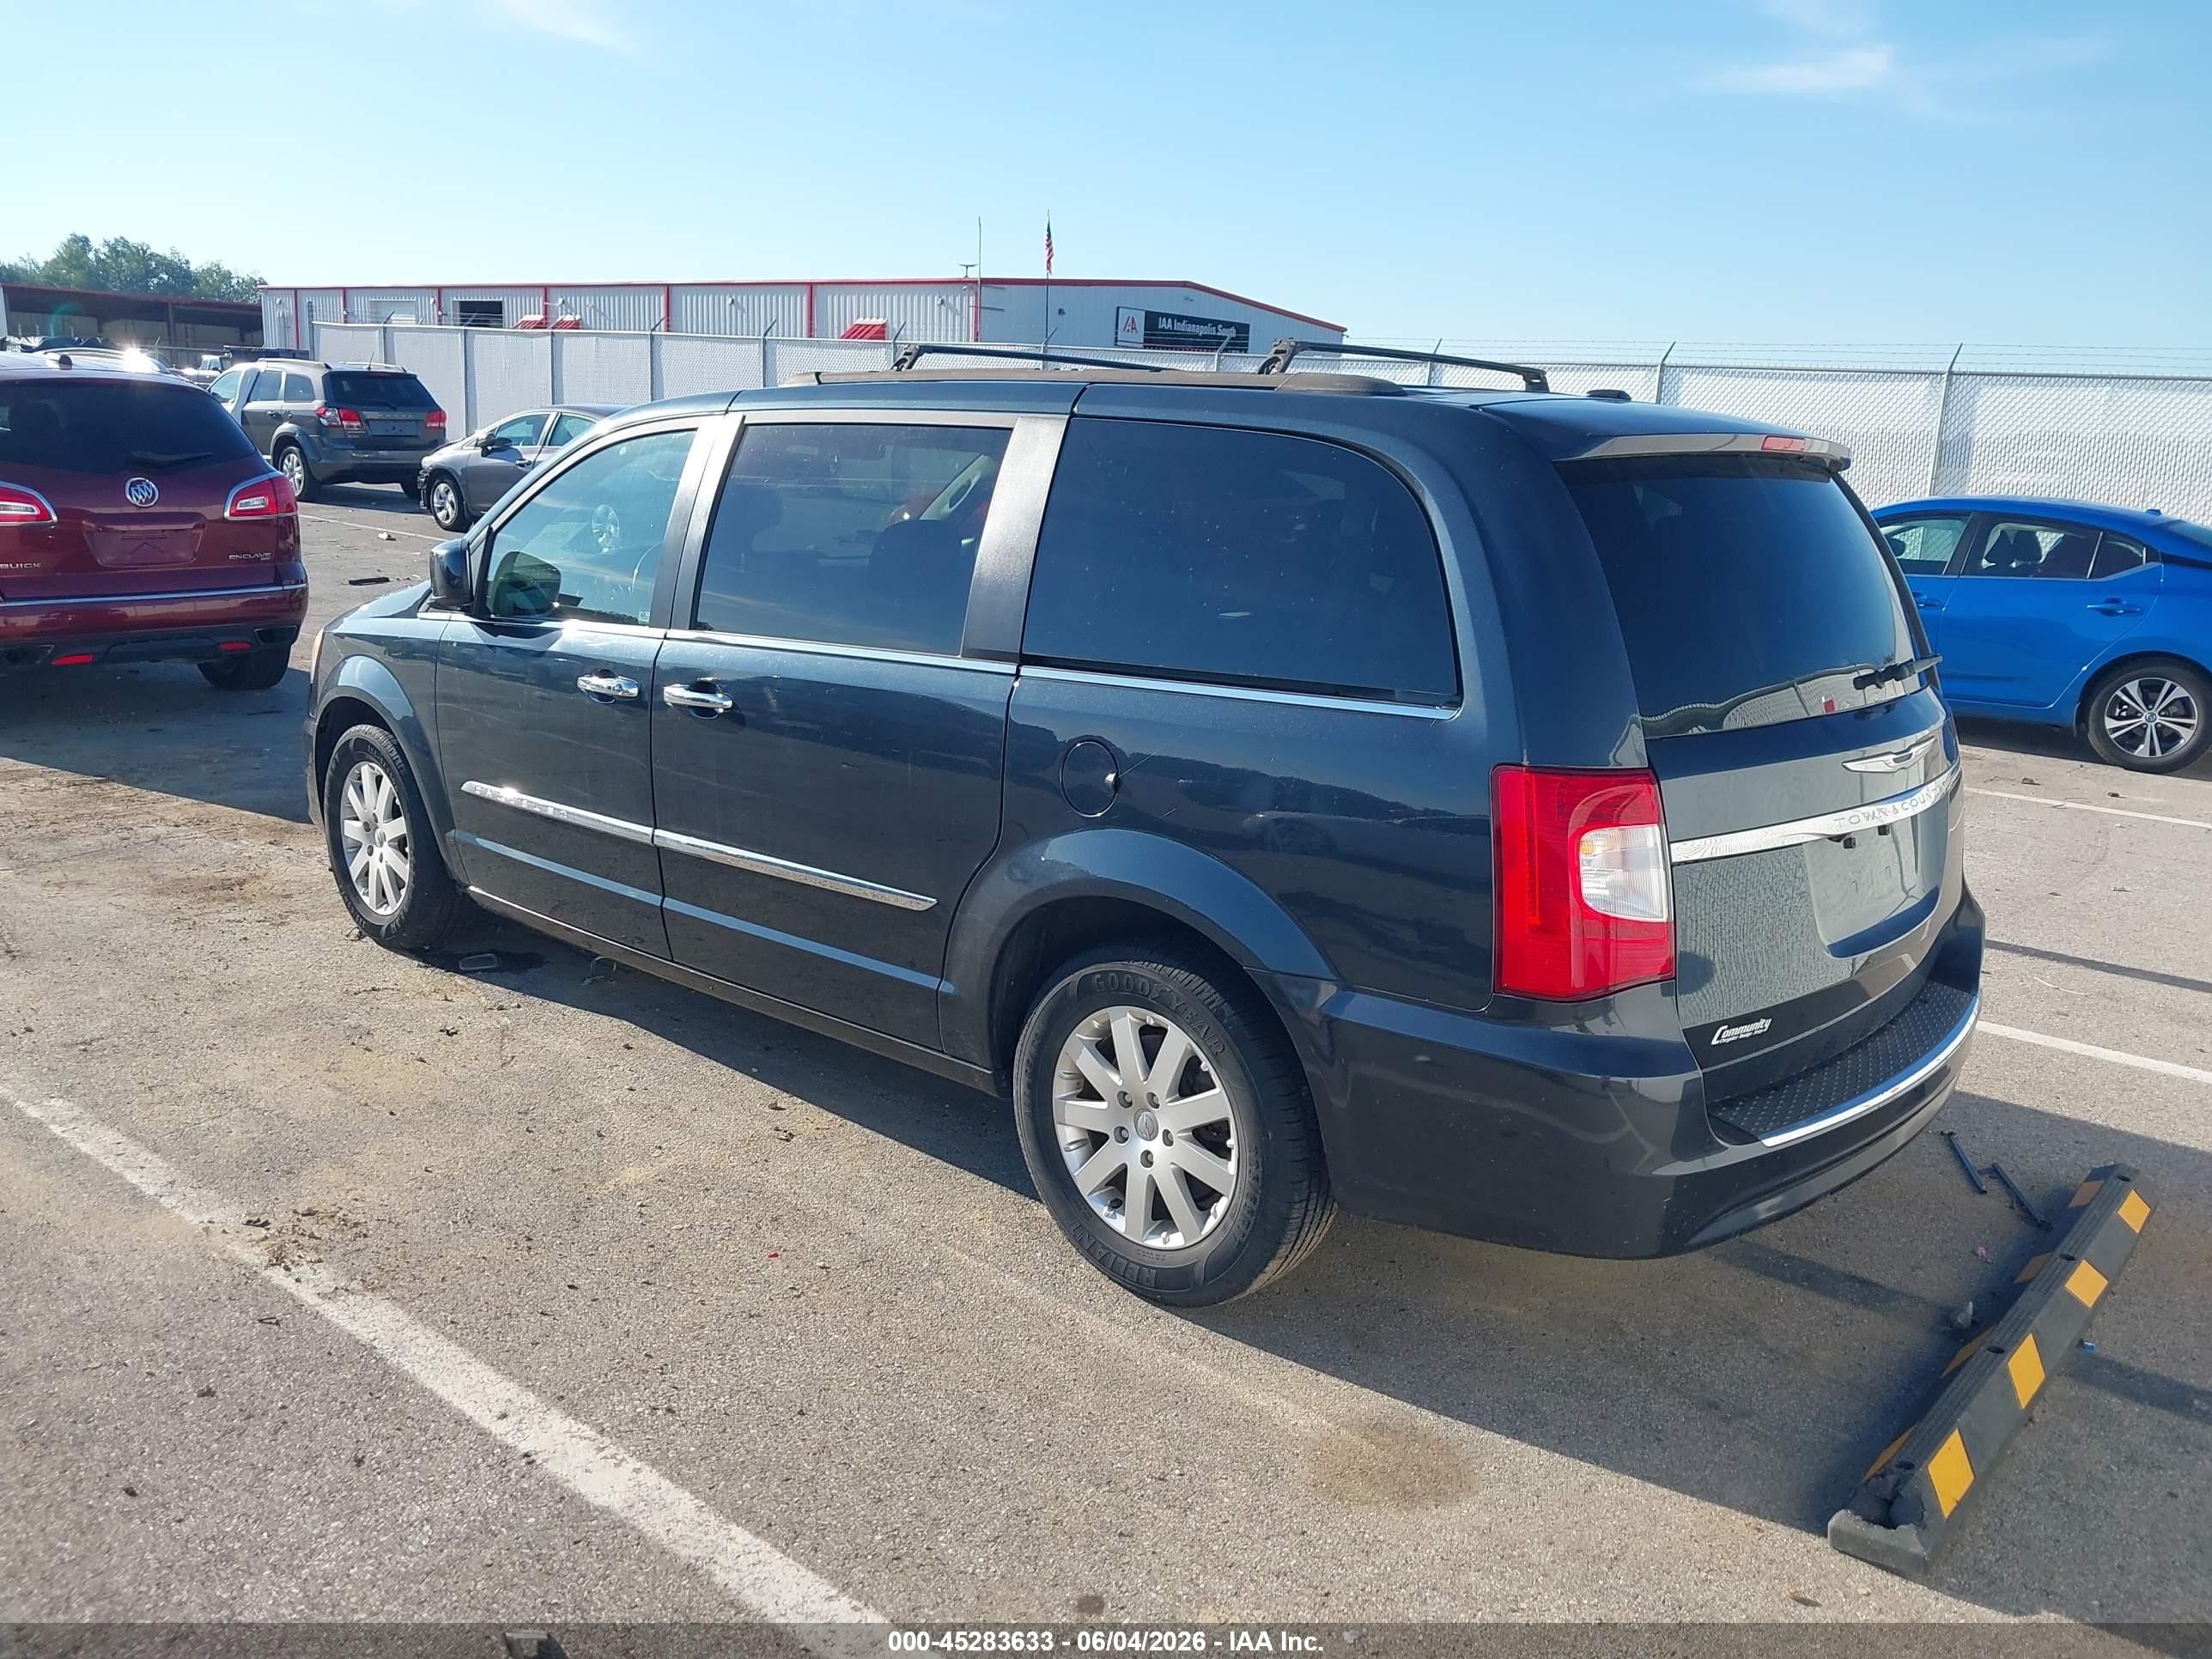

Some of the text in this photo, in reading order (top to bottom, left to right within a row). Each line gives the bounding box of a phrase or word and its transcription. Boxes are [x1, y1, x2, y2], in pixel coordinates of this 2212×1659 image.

[1158, 316, 1173, 331] IAA
[1173, 319, 1217, 337] Indianapolis
[1833, 807, 1890, 828] TOWN
[1711, 1018, 1772, 1046] Community
